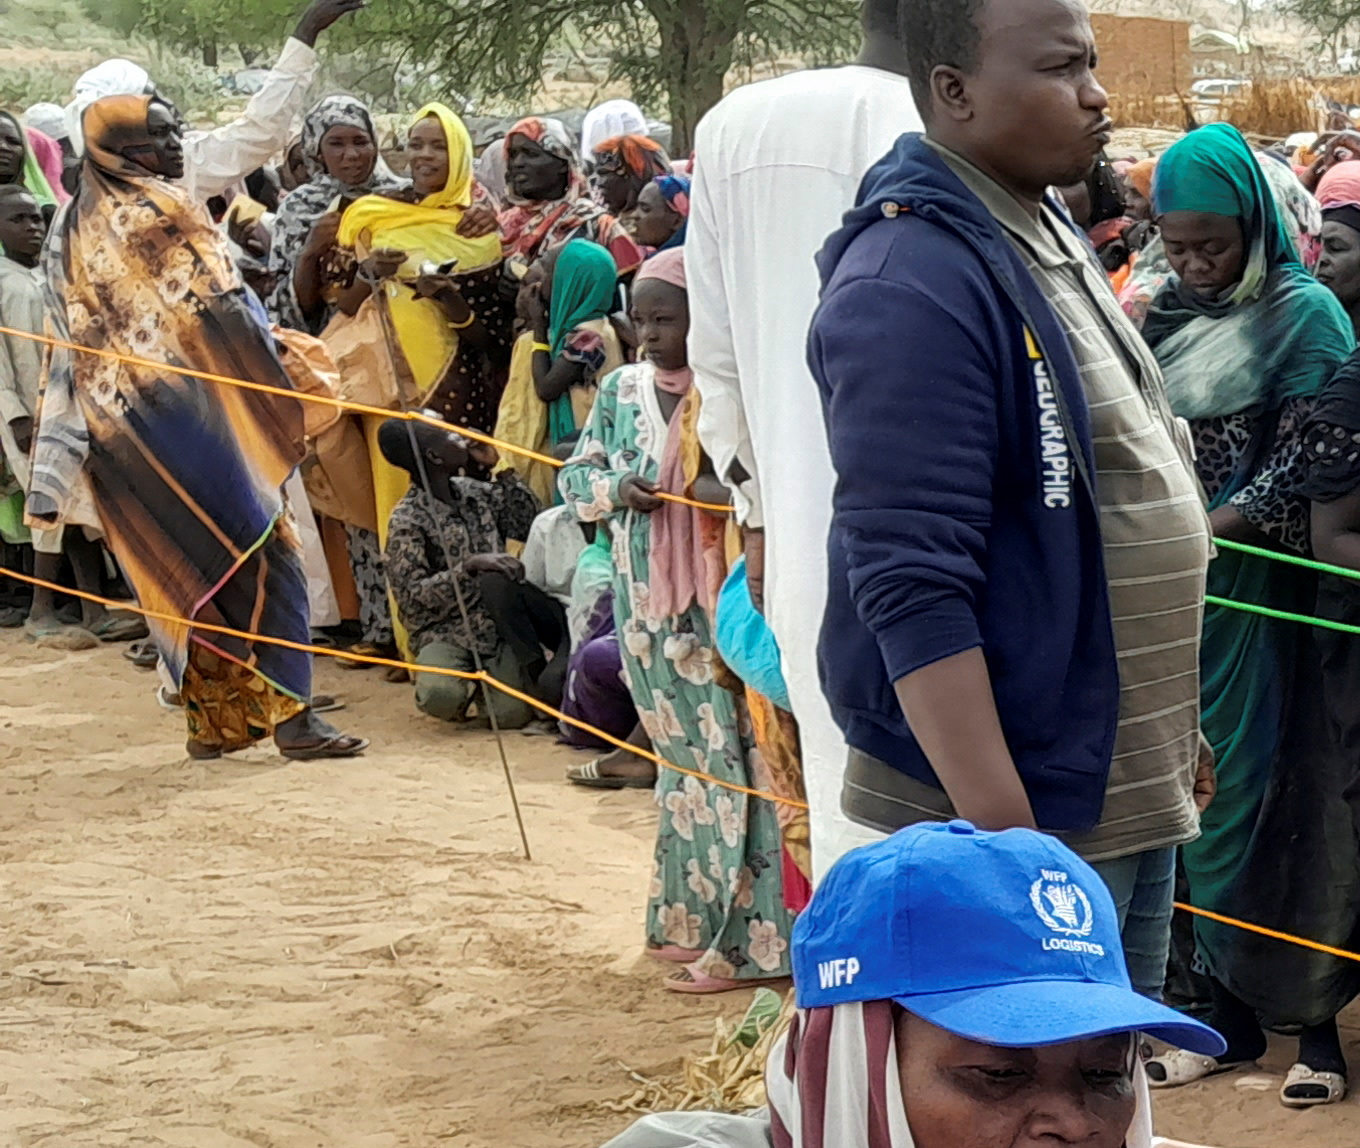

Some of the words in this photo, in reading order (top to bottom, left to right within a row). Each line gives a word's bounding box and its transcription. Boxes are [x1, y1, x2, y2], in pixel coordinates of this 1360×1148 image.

[1040, 868, 1068, 884] WFP
[1042, 937, 1105, 957] LOGISTICS
[817, 957, 861, 990] WFP
